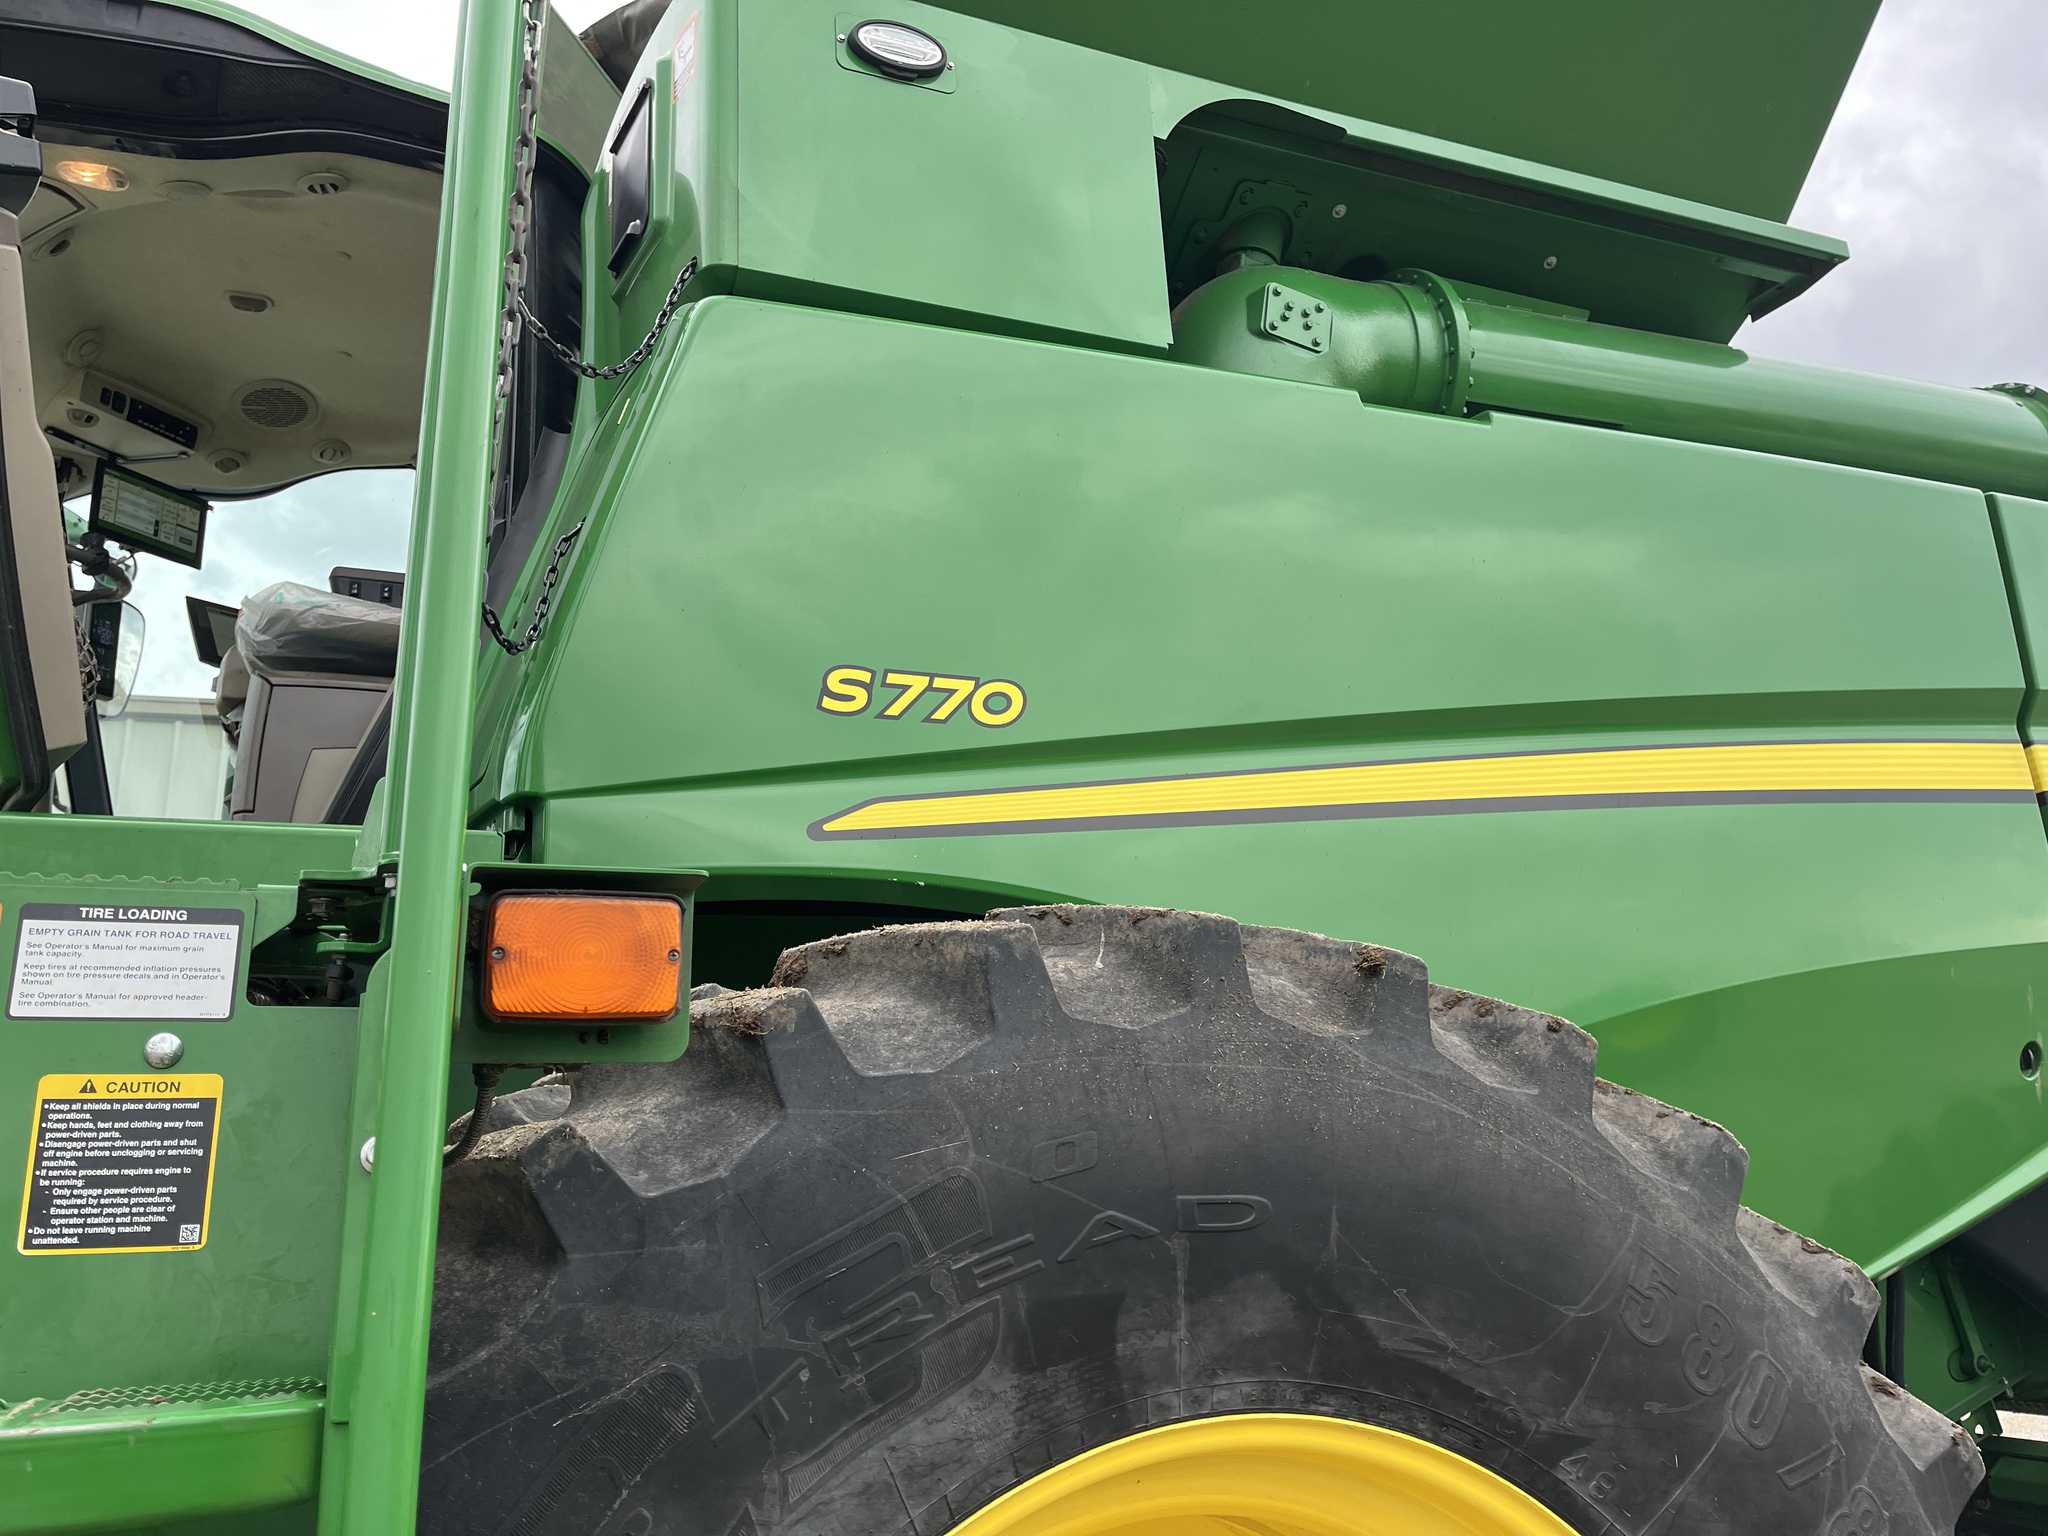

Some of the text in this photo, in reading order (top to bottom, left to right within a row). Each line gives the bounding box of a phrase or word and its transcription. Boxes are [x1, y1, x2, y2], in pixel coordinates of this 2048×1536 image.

[816, 664, 1027, 729] S770
[79, 907, 187, 921] TIRE LOADING
[28, 927, 231, 940] EMPTY GRAIN TANK FOR ROAD TRAVEL
[44, 942, 89, 950] Operator's
[182, 945, 204, 953] grain
[45, 950, 85, 958] capacity.
[23, 962, 45, 971] Keep
[181, 972, 225, 981] Operator's
[37, 991, 82, 1000] Operator's
[132, 993, 173, 1001] approved
[105, 1081, 180, 1093] CAUTION
[50, 1102, 70, 1111] Keep
[70, 1102, 81, 1110] all
[82, 1102, 111, 1110] shields
[121, 1102, 144, 1111] place
[144, 1101, 171, 1110] during
[172, 1101, 199, 1109] normal
[47, 1111, 92, 1121] operations.
[47, 1119, 203, 1130] Keep hands, feet and clothing away from
[45, 1130, 121, 1140] power-driven parts.
[44, 1138, 197, 1149] Disengage power-driven parts and shut
[42, 1149, 55, 1157] off
[55, 1149, 83, 1158] engine
[84, 1149, 110, 1157] before
[111, 1148, 156, 1158] unclogging
[167, 1147, 203, 1156] servicing
[41, 1158, 78, 1166] machine.
[41, 1168, 47, 1176] If
[47, 1168, 77, 1176] service
[78, 1167, 119, 1177] procedure
[120, 1167, 153, 1176] requires
[154, 1166, 181, 1176] engine
[39, 1177, 85, 1187] be running:
[52, 1185, 177, 1197] Only engage power-driven parts
[52, 1195, 172, 1206] required by service procedure.
[49, 1206, 79, 1215] Ensure
[79, 1206, 102, 1214] other
[102, 1205, 130, 1215] people
[145, 1204, 166, 1212] clear
[166, 1204, 176, 1212] of
[50, 1214, 168, 1226] operator station and machine.
[33, 1224, 151, 1234] Do not leave running machine
[31, 1235, 79, 1244] unattended.
